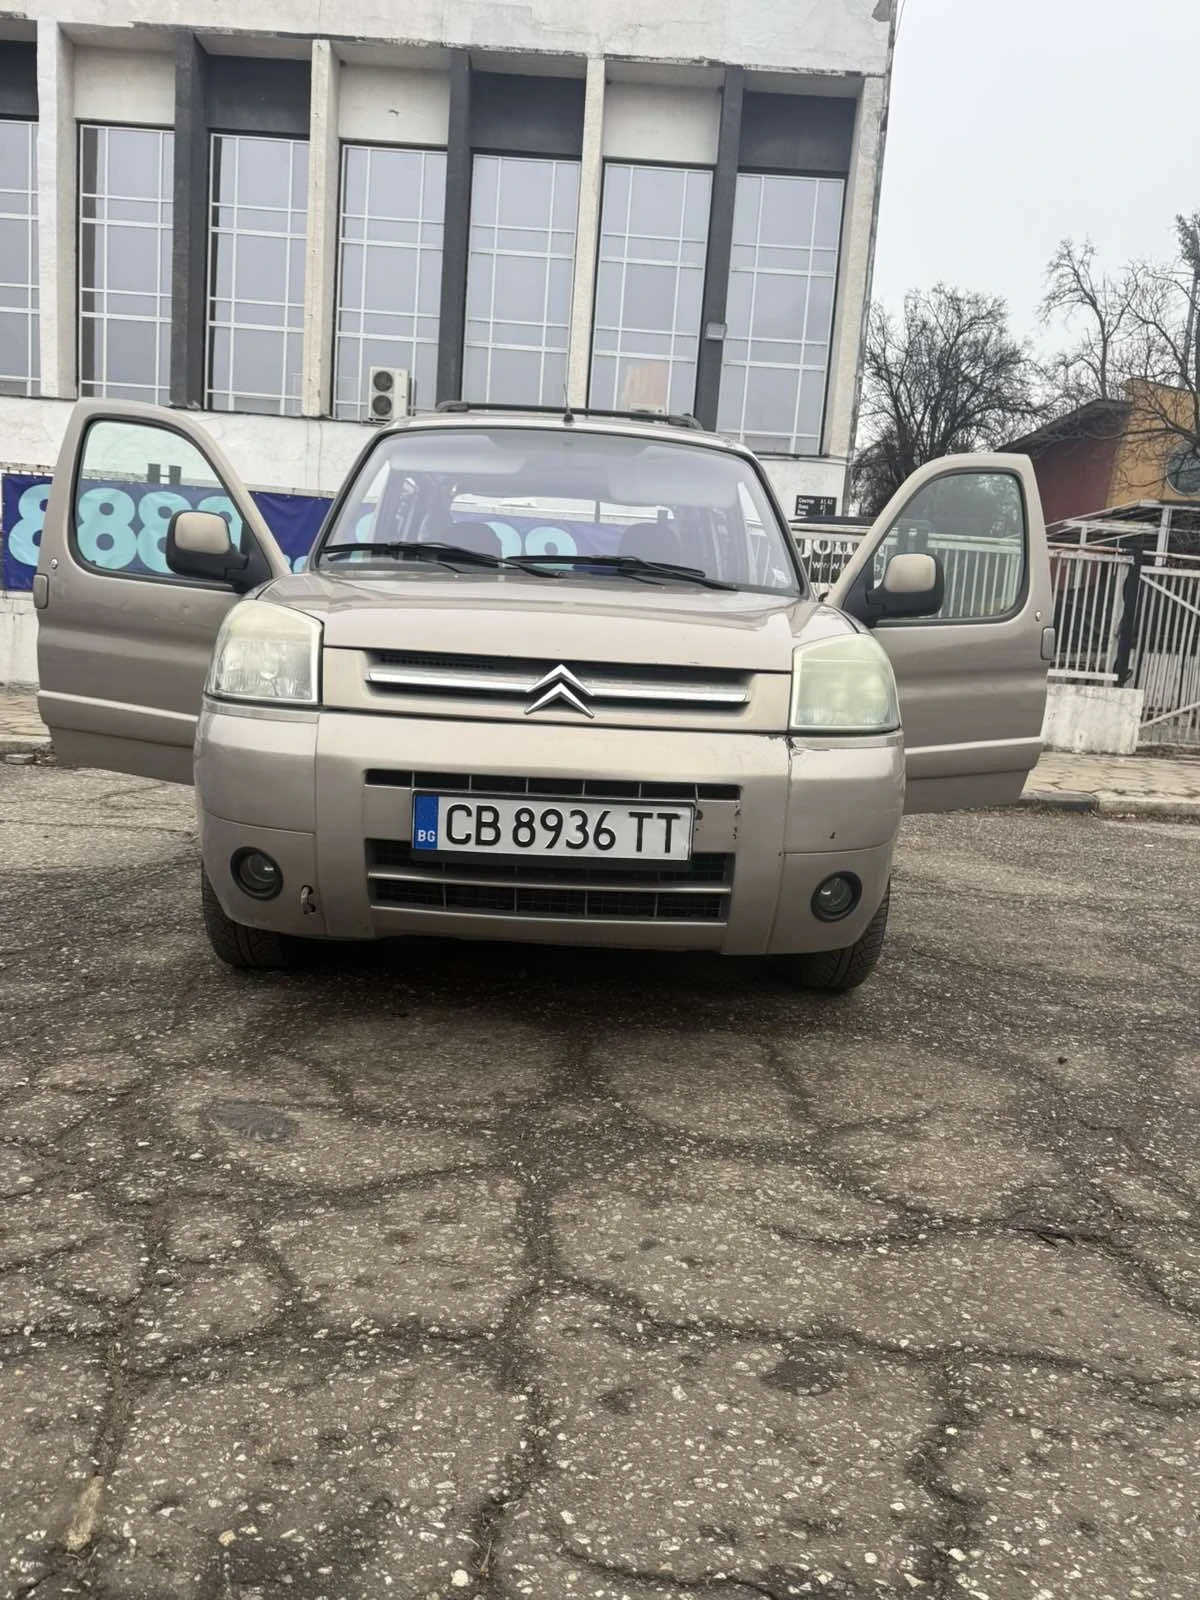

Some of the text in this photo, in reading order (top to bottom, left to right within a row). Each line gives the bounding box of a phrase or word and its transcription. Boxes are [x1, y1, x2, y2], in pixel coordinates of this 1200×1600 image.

[417, 829, 436, 843] BG
[446, 803, 681, 853] CB 8936 TT
